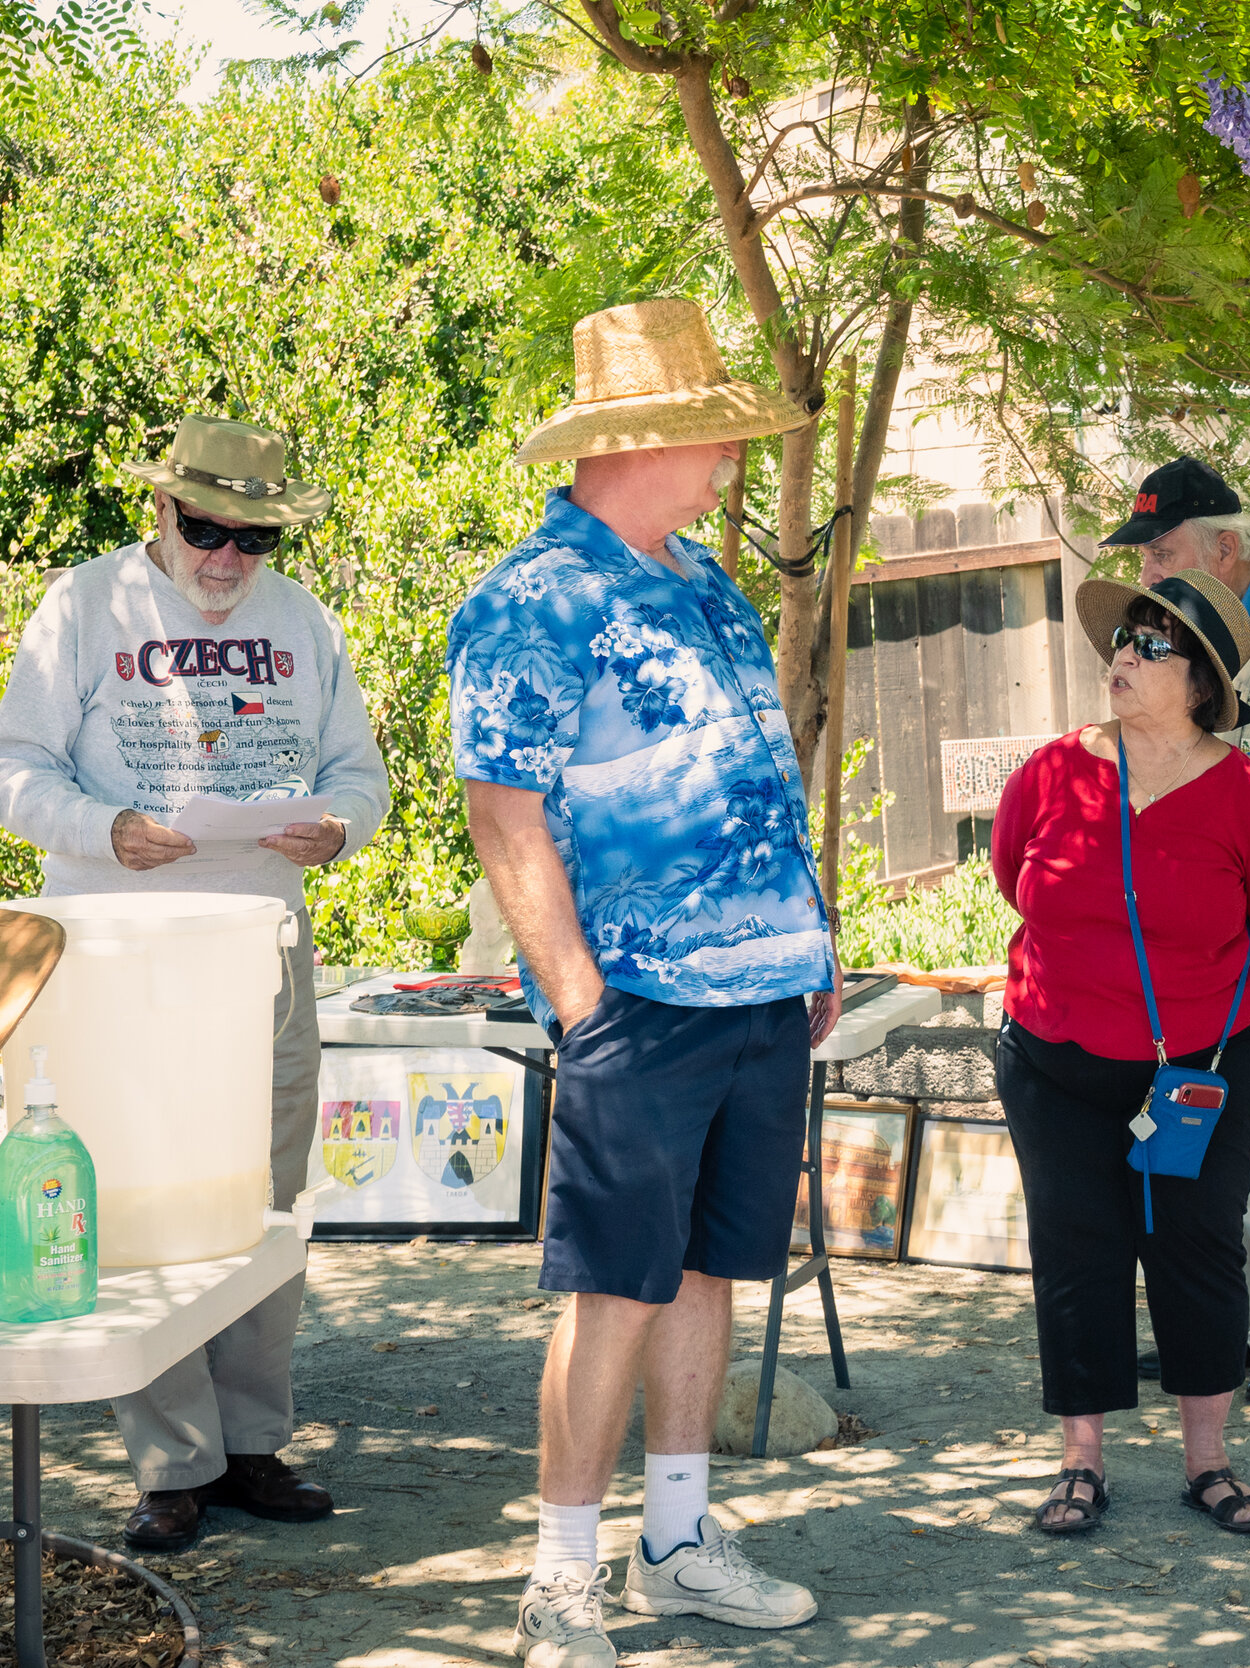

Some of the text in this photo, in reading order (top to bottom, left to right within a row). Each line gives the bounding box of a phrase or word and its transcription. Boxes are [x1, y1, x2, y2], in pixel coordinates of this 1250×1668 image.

[137, 638, 277, 687] CZECH
[185, 700, 215, 710] person
[218, 698, 228, 706] of
[266, 697, 293, 706] descent
[128, 718, 155, 728] loves
[158, 718, 199, 729] festivals,
[201, 719, 222, 728] food
[225, 719, 243, 728] and
[246, 718, 262, 727] fun
[276, 716, 301, 726] known
[122, 737, 299, 752] for hospitality and generosity
[137, 761, 176, 771] favorite
[178, 761, 205, 771] foods
[208, 762, 241, 771] include
[244, 760, 266, 770] roast
[136, 780, 277, 795] & potato dumplings, and kol
[133, 801, 141, 809] 5:
[144, 804, 174, 813] excels
[36, 1198, 86, 1218] HAND
[71, 1212, 87, 1237] Rx
[50, 1242, 76, 1255] Hand
[40, 1253, 84, 1267] Sanitizer
